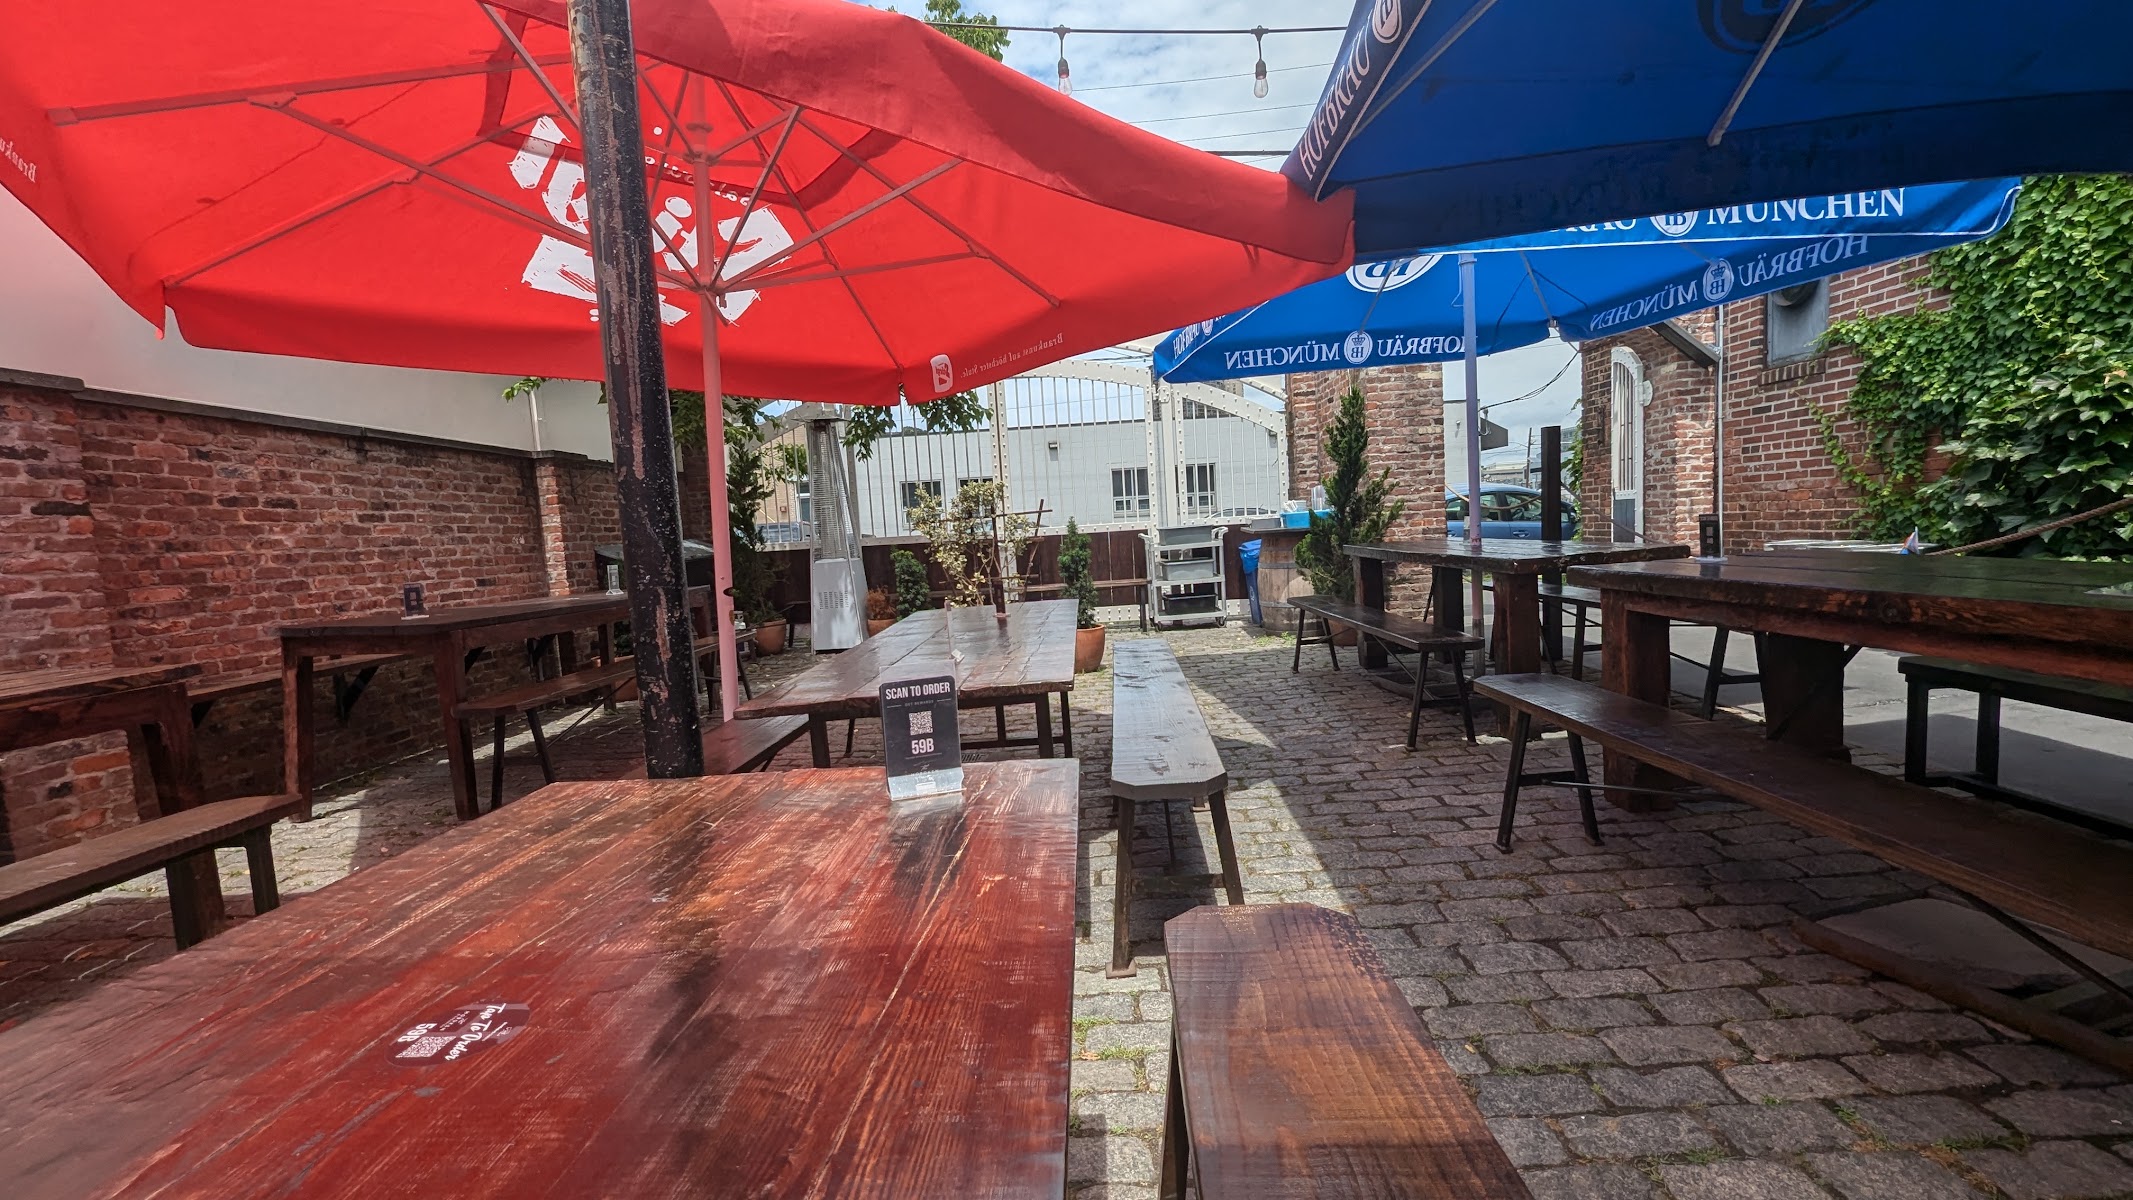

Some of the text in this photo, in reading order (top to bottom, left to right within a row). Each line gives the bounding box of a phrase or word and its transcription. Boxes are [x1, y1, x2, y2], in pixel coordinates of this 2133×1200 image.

[885, 682, 950, 700] SCAN TO ORDER
[911, 738, 935, 754] 59B
[397, 1023, 437, 1043] 59B
[470, 1020, 493, 1032] To
[444, 1031, 483, 1061] Order
